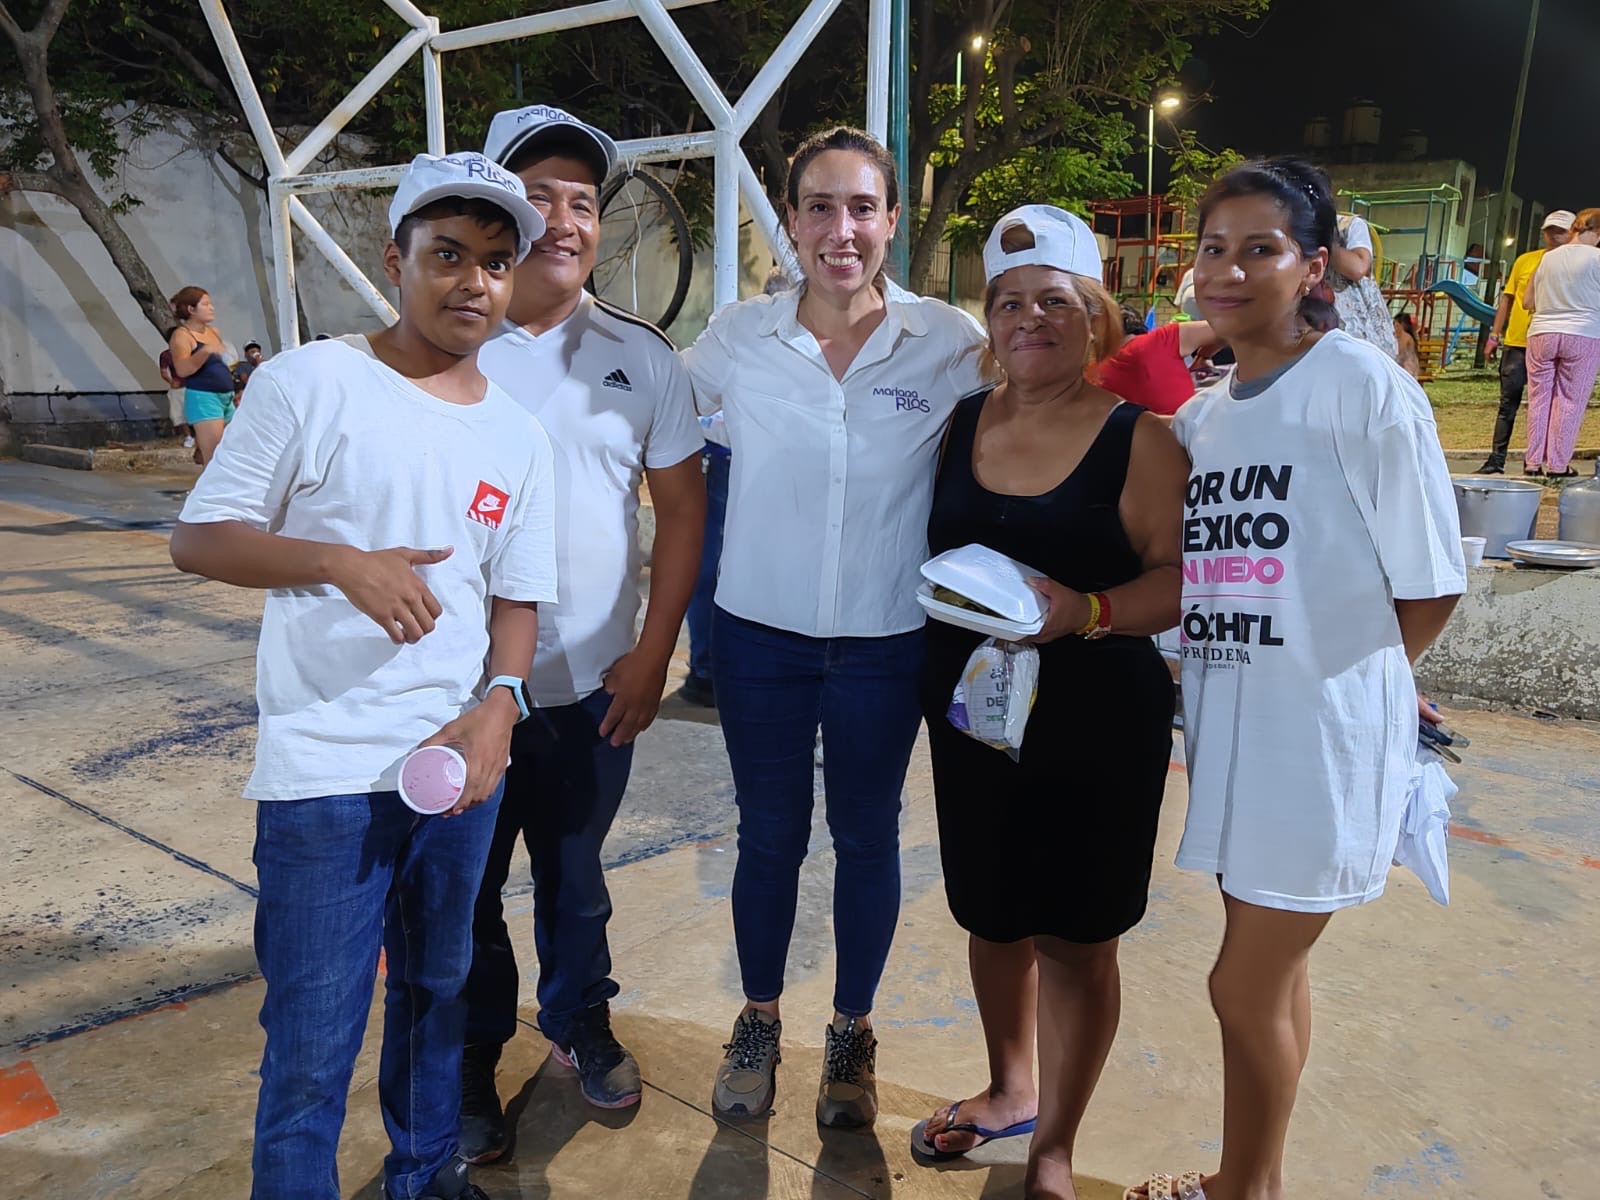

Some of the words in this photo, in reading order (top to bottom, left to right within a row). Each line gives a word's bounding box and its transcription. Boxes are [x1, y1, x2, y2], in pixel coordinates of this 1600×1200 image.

[1185, 471, 1225, 508] OR
[1230, 465, 1293, 501] UN
[1184, 509, 1290, 552] ÉXICO
